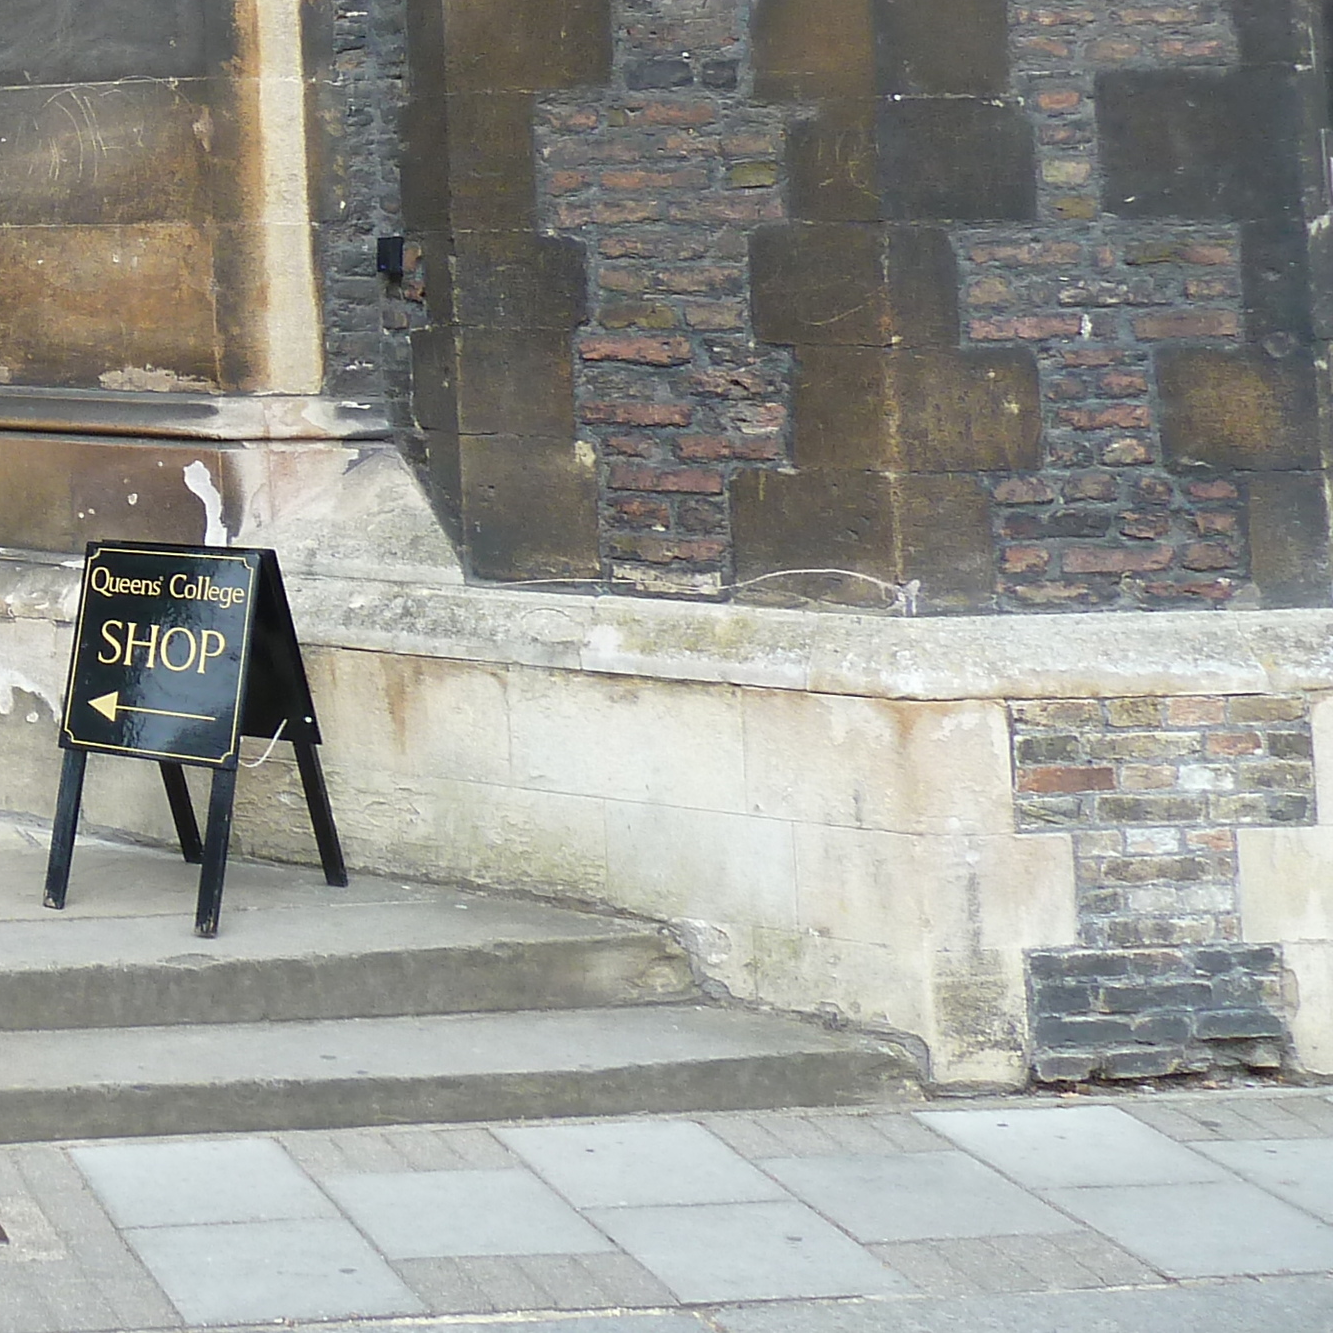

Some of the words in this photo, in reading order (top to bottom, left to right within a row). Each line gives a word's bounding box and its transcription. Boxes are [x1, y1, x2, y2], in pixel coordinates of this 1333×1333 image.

[91, 567, 164, 597] Queens'
[169, 574, 245, 609] College
[97, 619, 226, 674] SHOP
